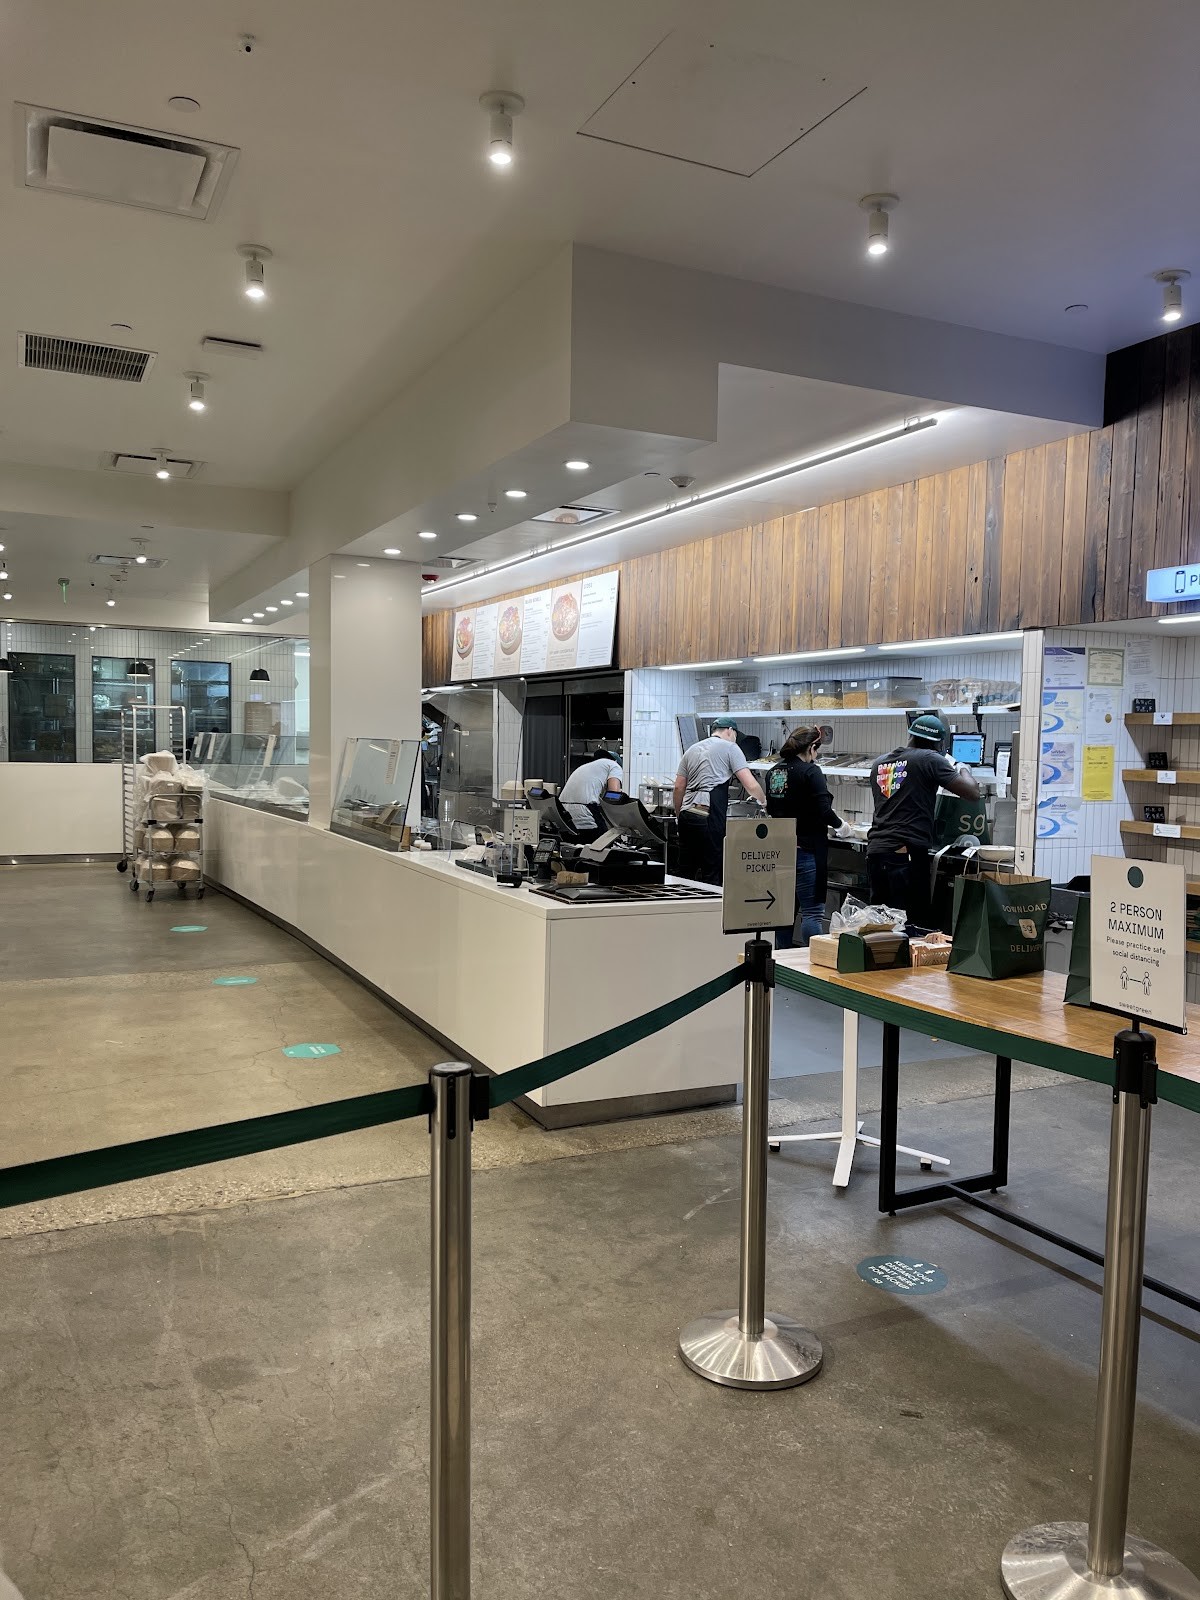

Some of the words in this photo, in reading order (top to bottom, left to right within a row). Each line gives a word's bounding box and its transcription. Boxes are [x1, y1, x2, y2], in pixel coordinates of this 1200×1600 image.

[1190, 574, 1200, 586] P
[878, 759, 908, 772] passion
[876, 770, 908, 782] purpose
[881, 782, 901, 793] pride
[958, 812, 986, 836] sg
[741, 850, 780, 860] DELIVERY
[746, 863, 776, 873] PICKUP
[1002, 903, 1048, 913] DOWNLOAD
[1110, 901, 1116, 913] 2
[1119, 903, 1162, 921] PERSON
[1108, 918, 1164, 940] MAXIMUM
[1106, 936, 1125, 946] Please
[1126, 941, 1151, 952] practice
[1153, 945, 1166, 955] safe
[1112, 950, 1129, 959] social
[1130, 952, 1160, 967] distancing
[1118, 1002, 1152, 1015] sweetgreen
